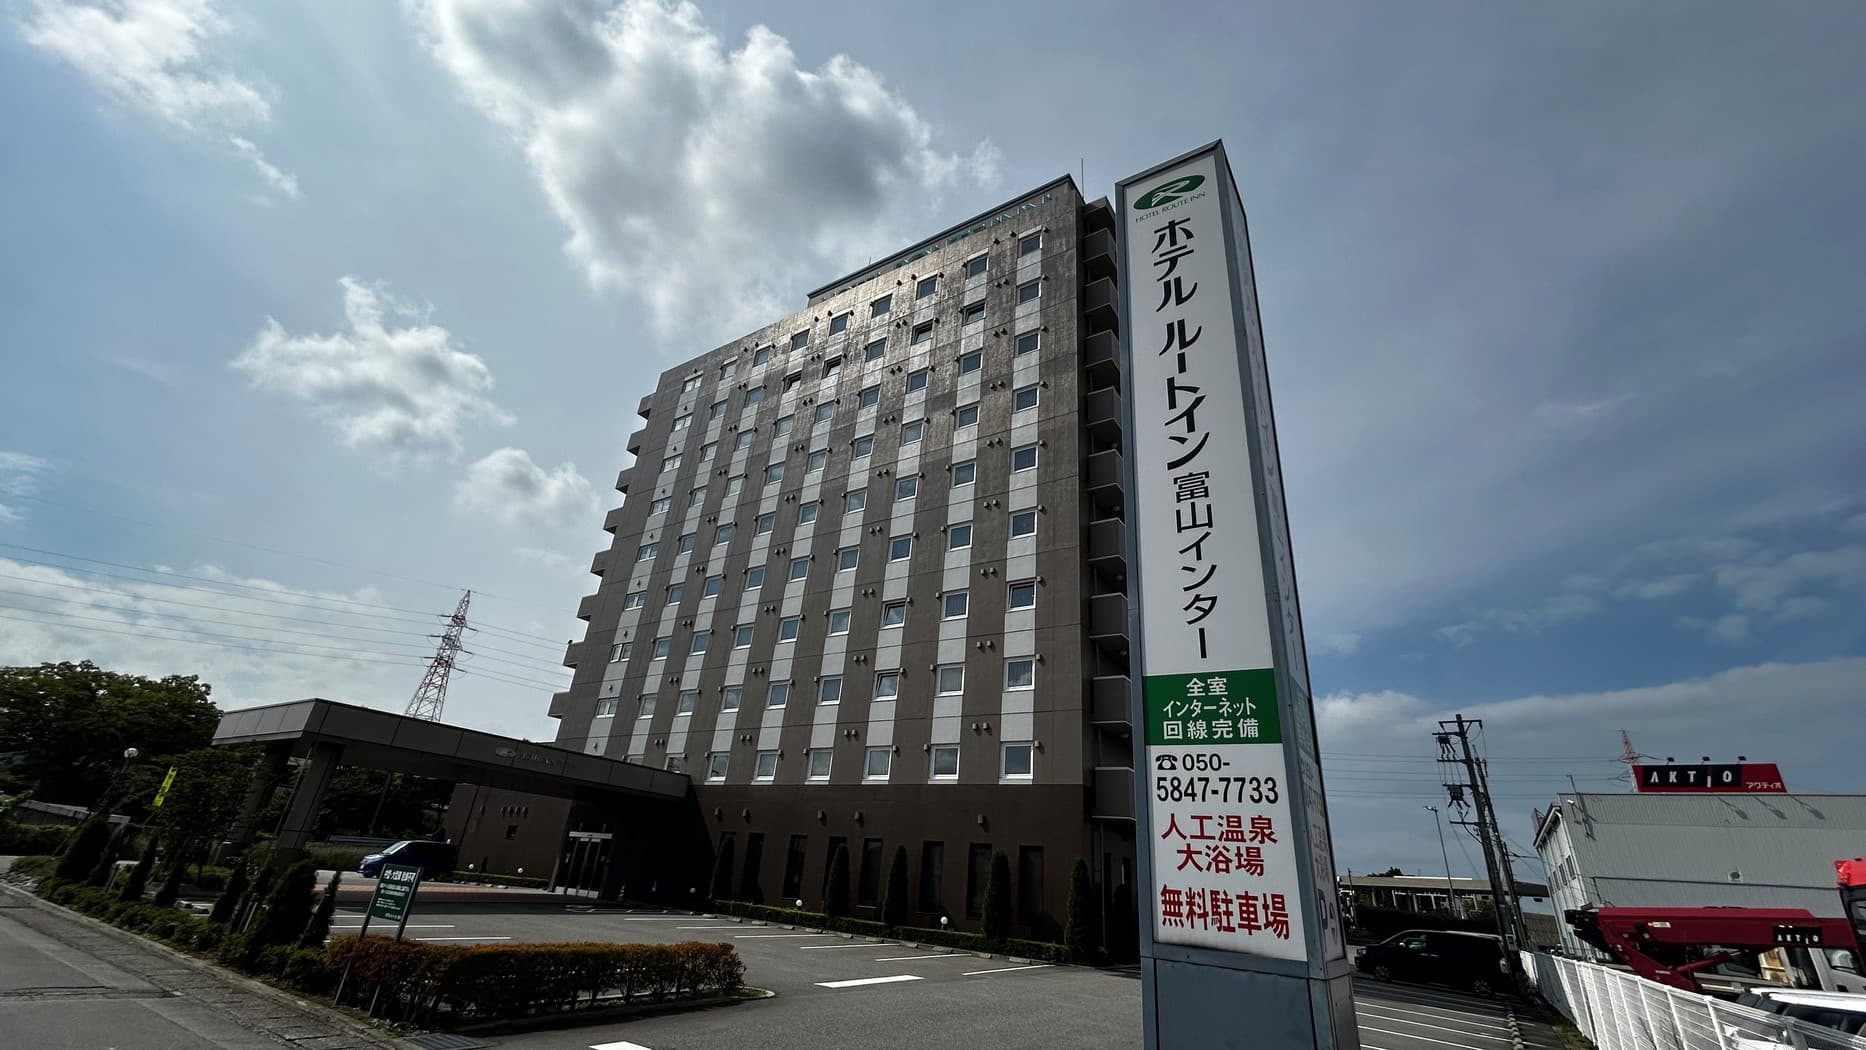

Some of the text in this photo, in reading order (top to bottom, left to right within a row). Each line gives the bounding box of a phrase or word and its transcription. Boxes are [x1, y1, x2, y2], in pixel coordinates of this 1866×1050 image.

[1135, 191, 1206, 223] HOTEL ROUTE INN
[1186, 676, 1229, 697] 全室
[1163, 697, 1257, 719] インターネット
[1163, 718, 1259, 740] 回線完備
[1182, 753, 1230, 772] 050-
[1156, 776, 1279, 804] 5847-7733
[1650, 770, 1733, 788] AKTIO
[1161, 813, 1278, 845] 人工温泉
[1176, 843, 1265, 876] 大浴場
[1160, 884, 1290, 940] 無料駐車場
